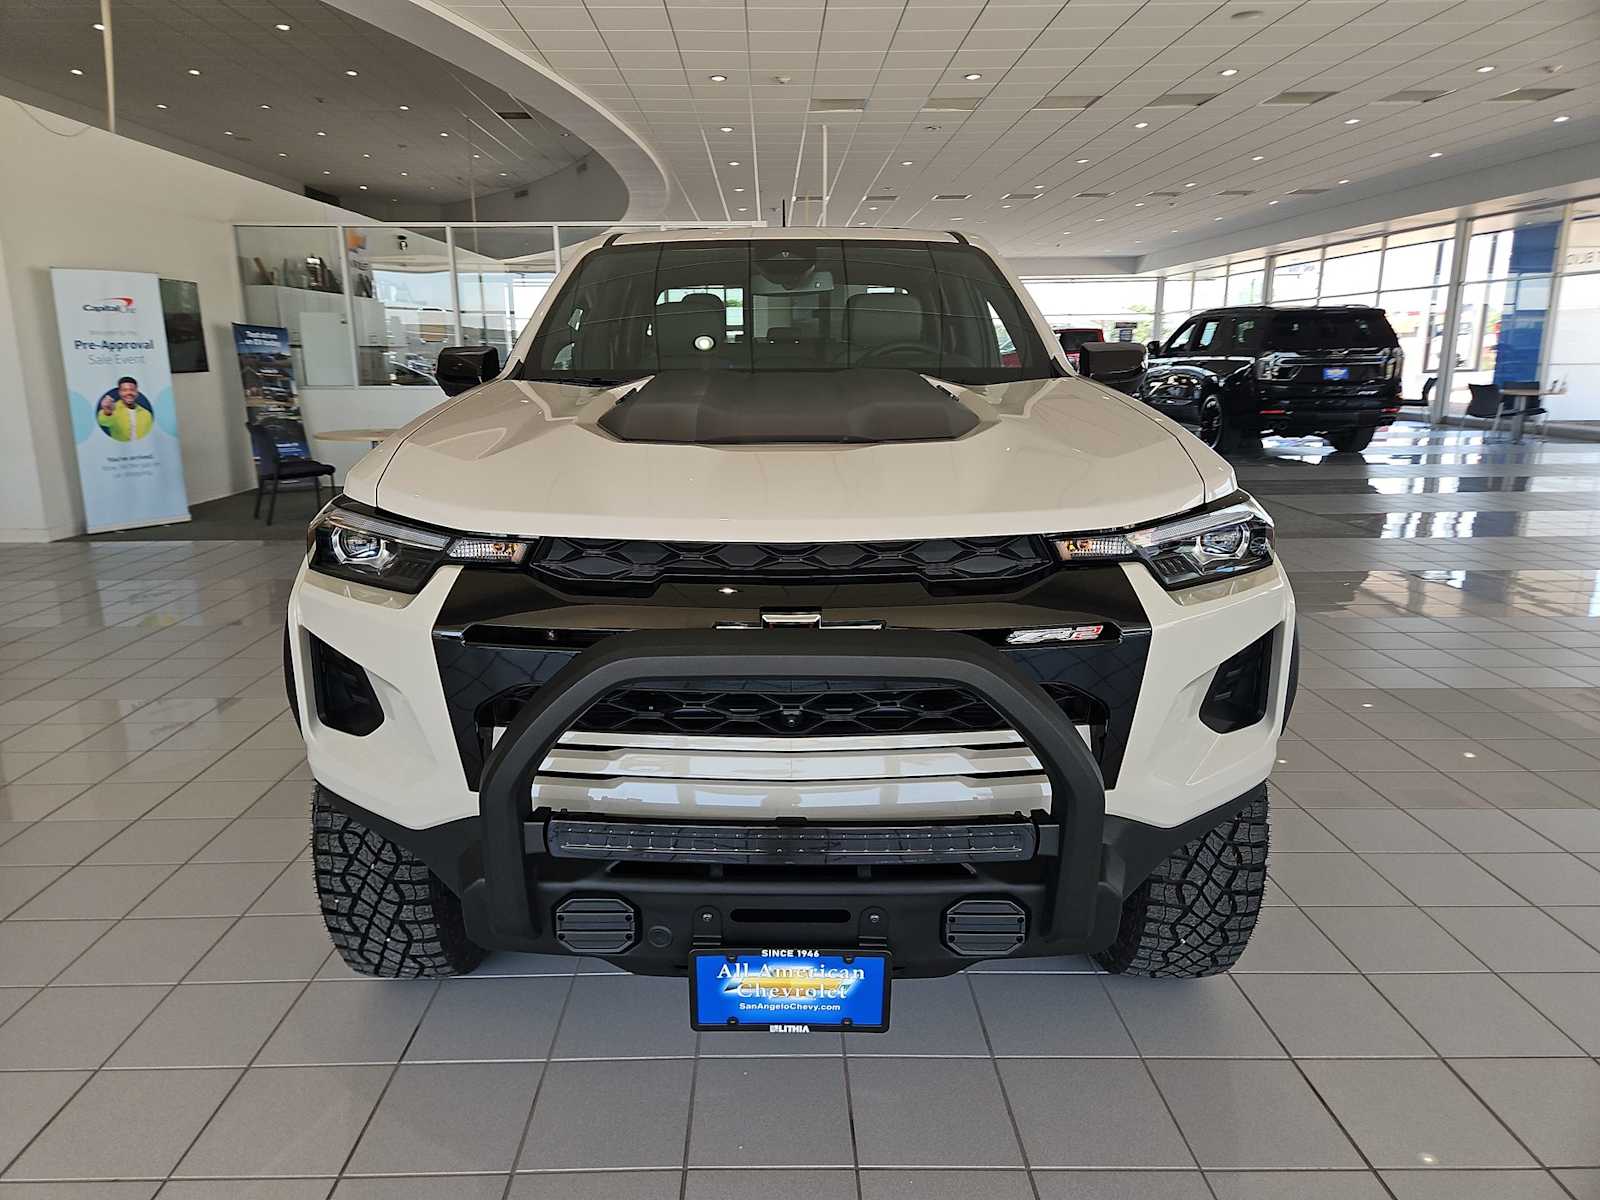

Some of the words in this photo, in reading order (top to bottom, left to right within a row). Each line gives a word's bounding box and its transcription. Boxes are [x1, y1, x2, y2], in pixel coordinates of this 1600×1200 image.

[74, 339, 154, 352] Pre-Approval
[88, 353, 113, 365] Sale
[115, 353, 147, 365] Event
[1006, 625, 1104, 645] ZR2
[761, 949, 794, 958] SINCE
[797, 949, 820, 958] 1946
[716, 962, 749, 979] All
[759, 963, 865, 980] American
[736, 982, 848, 999] Chevrolet
[739, 1002, 841, 1012] SanAngeloChevy.com
